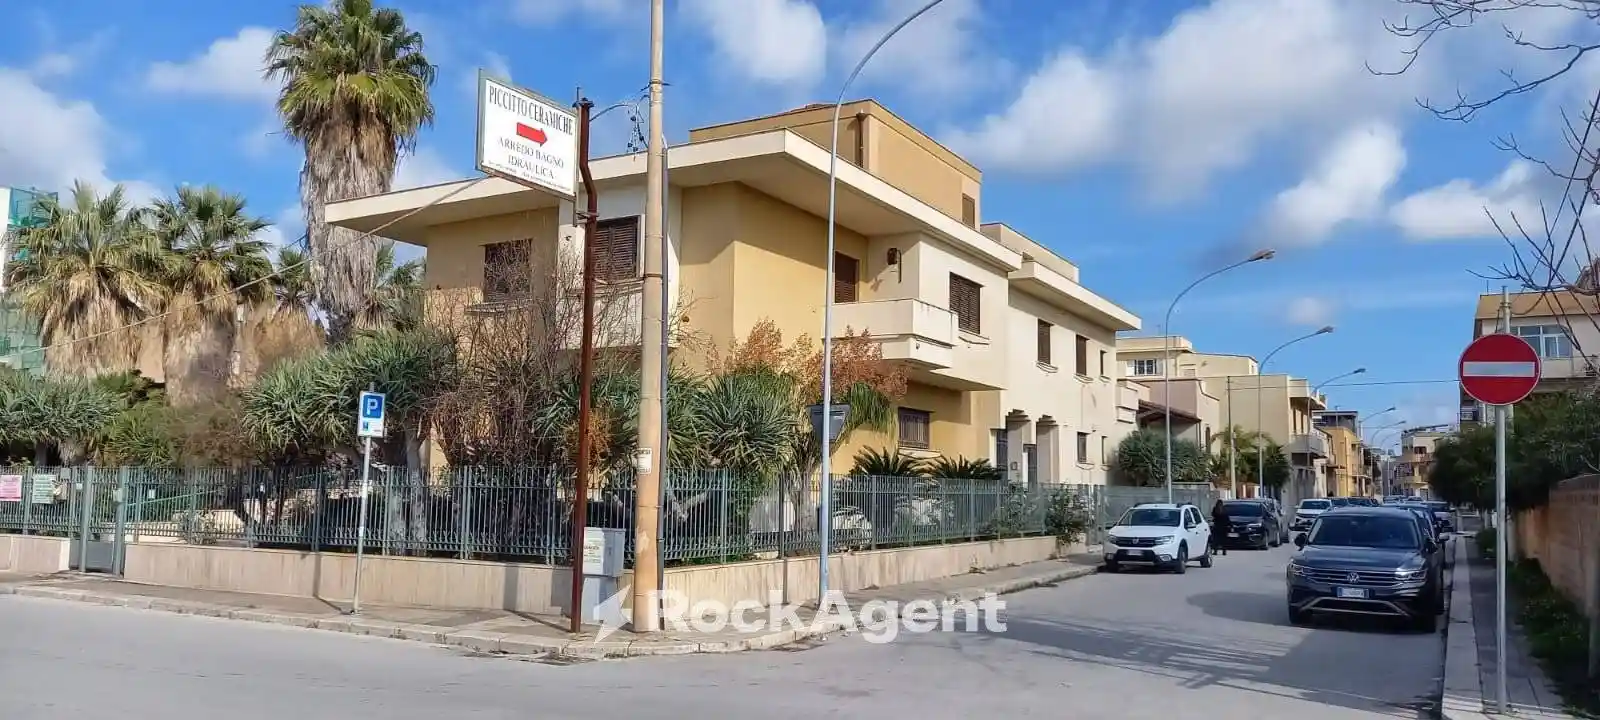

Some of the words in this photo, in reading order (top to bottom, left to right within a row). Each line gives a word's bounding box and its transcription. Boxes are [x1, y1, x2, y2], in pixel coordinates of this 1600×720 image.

[489, 85, 528, 117] PICCITTO
[528, 101, 573, 136] CERAMICHE
[498, 136, 534, 156] ARREDO
[536, 147, 564, 169] BAGNO
[508, 154, 554, 179] IDRAULICA
[366, 398, 378, 415] P
